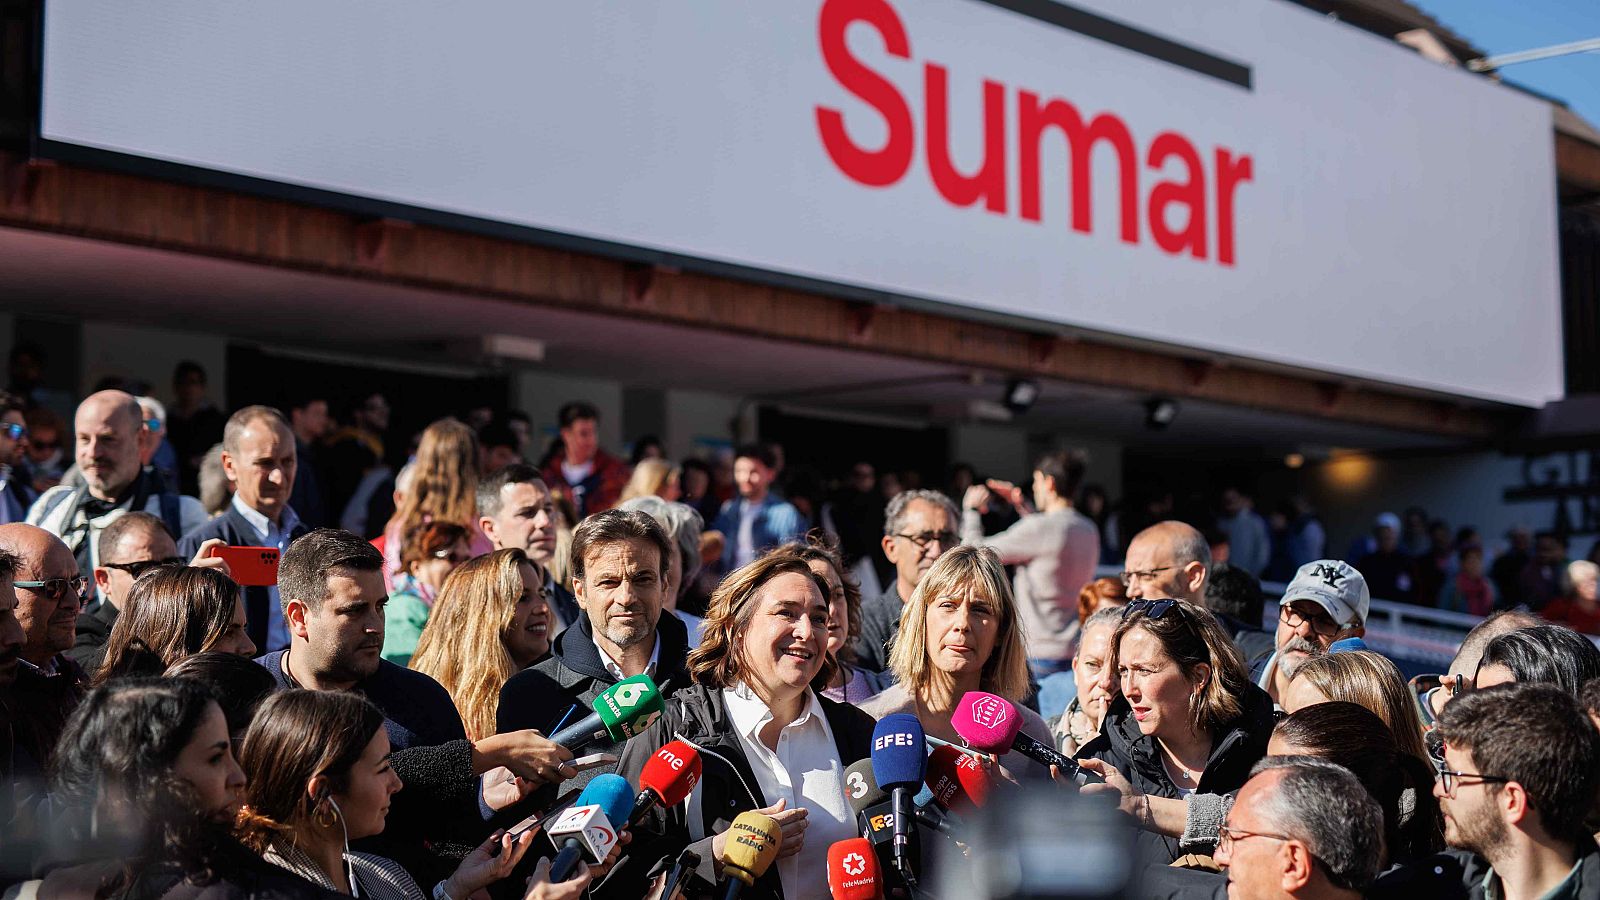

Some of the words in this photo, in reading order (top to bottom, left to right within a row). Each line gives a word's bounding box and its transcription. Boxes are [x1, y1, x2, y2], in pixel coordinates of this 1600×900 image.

[814, 0, 1254, 269] Sumar
[1310, 563, 1345, 588] NY
[657, 749, 684, 771] rne
[846, 771, 869, 799] 3
[736, 836, 764, 852] RADIO
